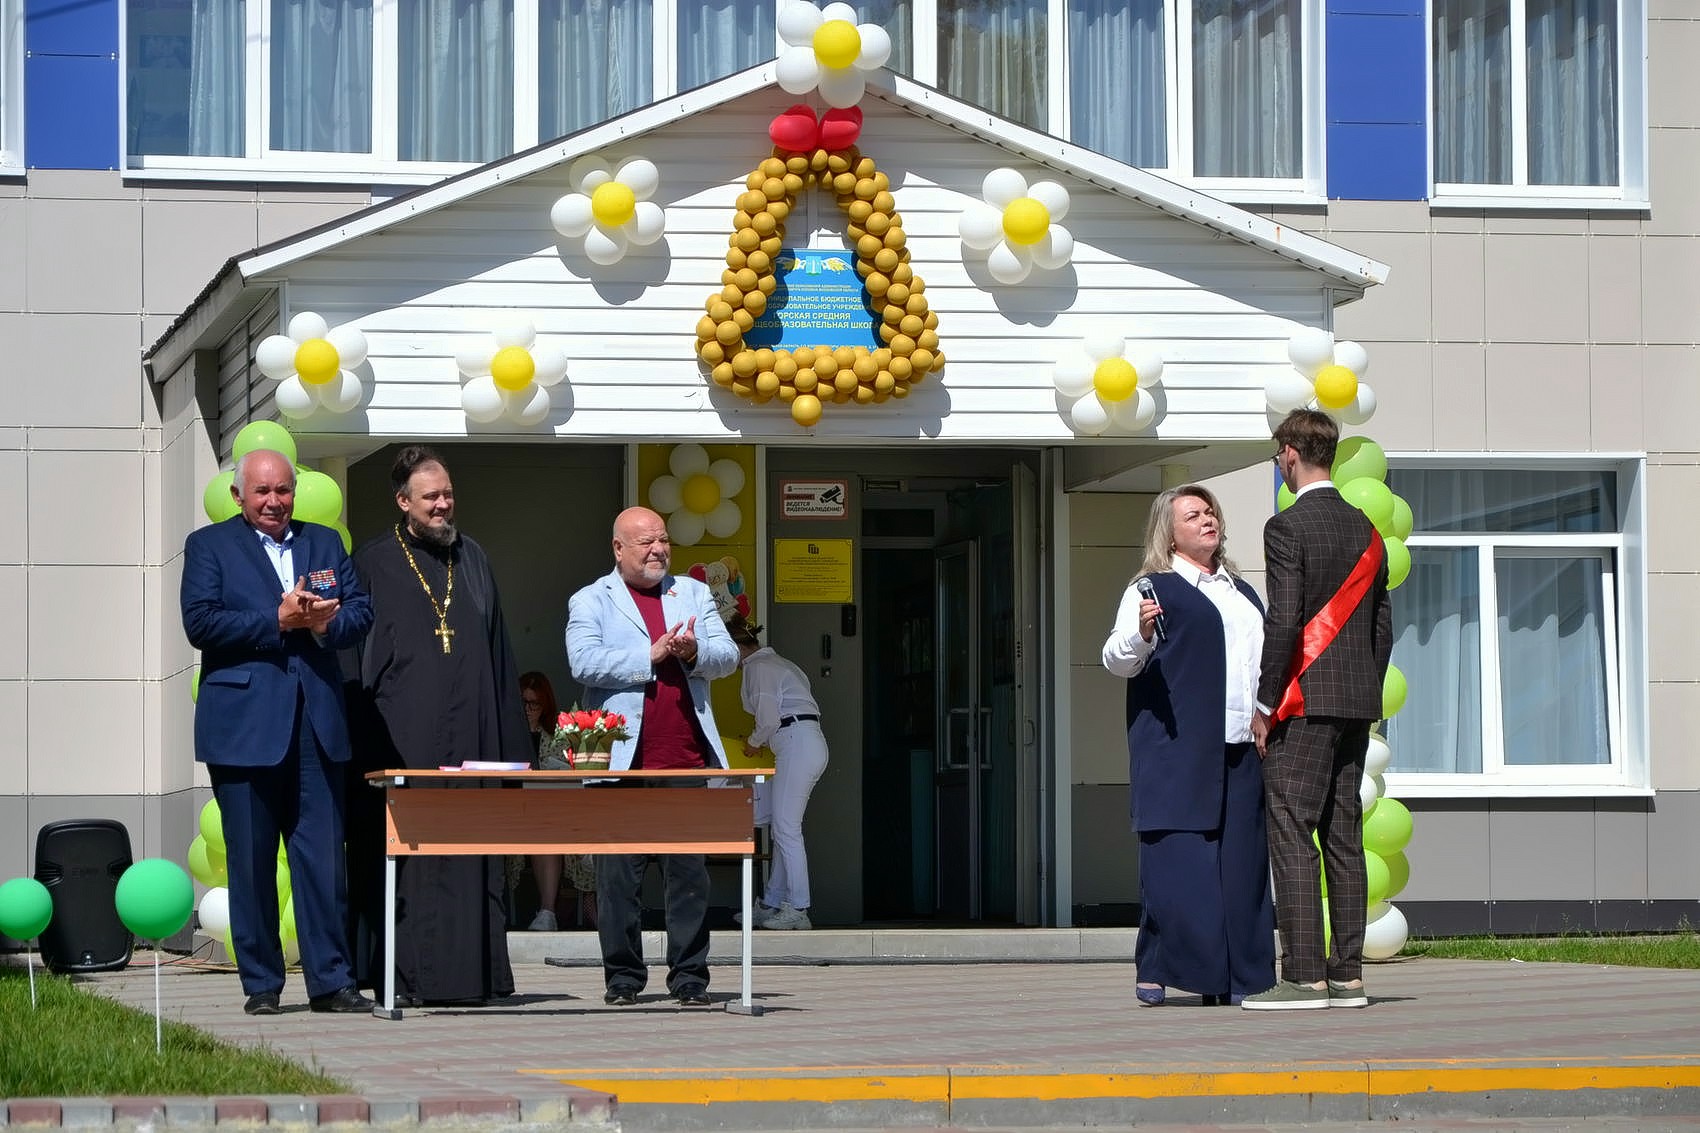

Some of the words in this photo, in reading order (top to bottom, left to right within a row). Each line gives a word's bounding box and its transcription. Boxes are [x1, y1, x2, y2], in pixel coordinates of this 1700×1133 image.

[820, 295, 862, 303] БЮДЖЕТНОЕ
[812, 312, 851, 320] СРЕДНЯЯ
[752, 320, 849, 329] ЩЕОБРАЗОВАТЕЛЬНАЯ
[850, 321, 880, 330] ШКОЛА
